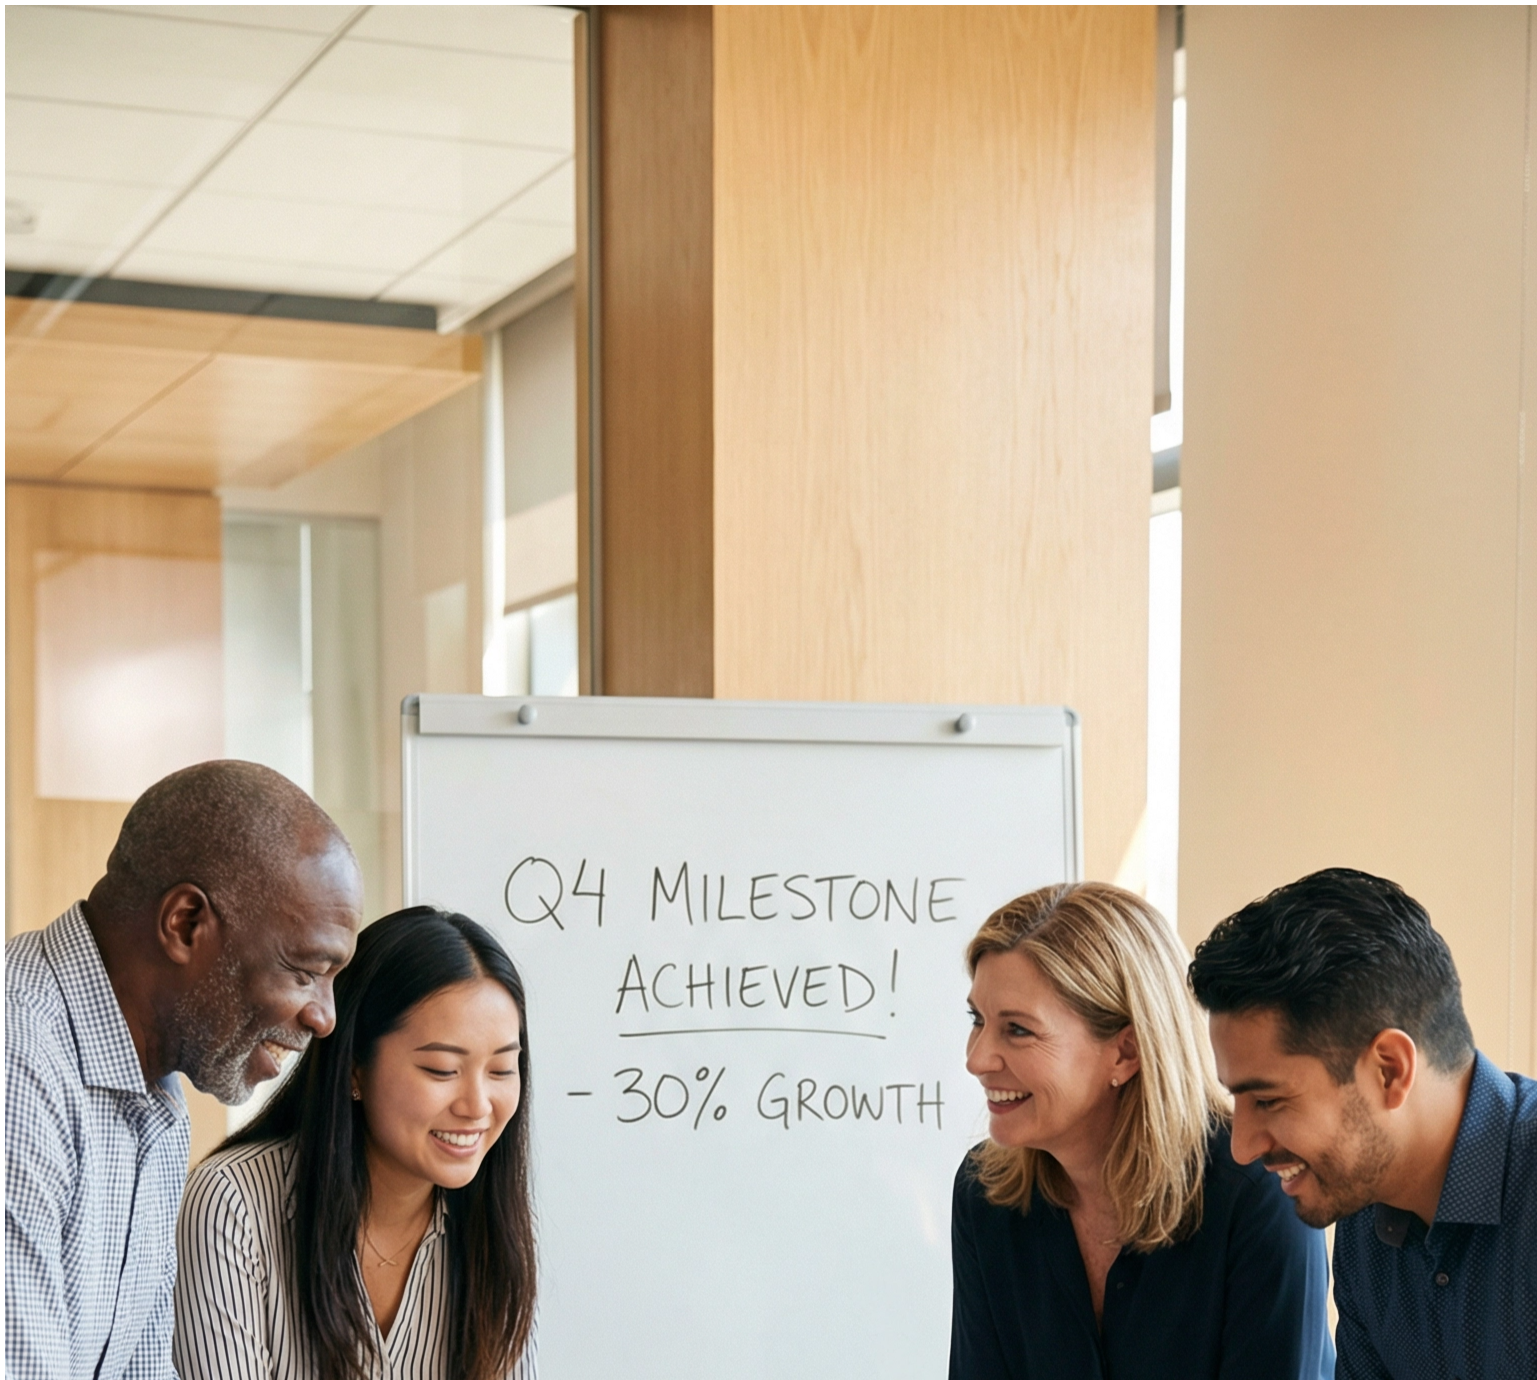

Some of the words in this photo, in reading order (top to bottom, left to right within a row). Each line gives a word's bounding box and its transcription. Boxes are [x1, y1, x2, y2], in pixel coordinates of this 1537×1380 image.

[504, 855, 607, 931] Q4
[651, 860, 966, 926] MILESTONE
[615, 948, 899, 1018] ACHIEVED!
[613, 1066, 728, 1131] 30%
[757, 1072, 945, 1131] GROWTH
